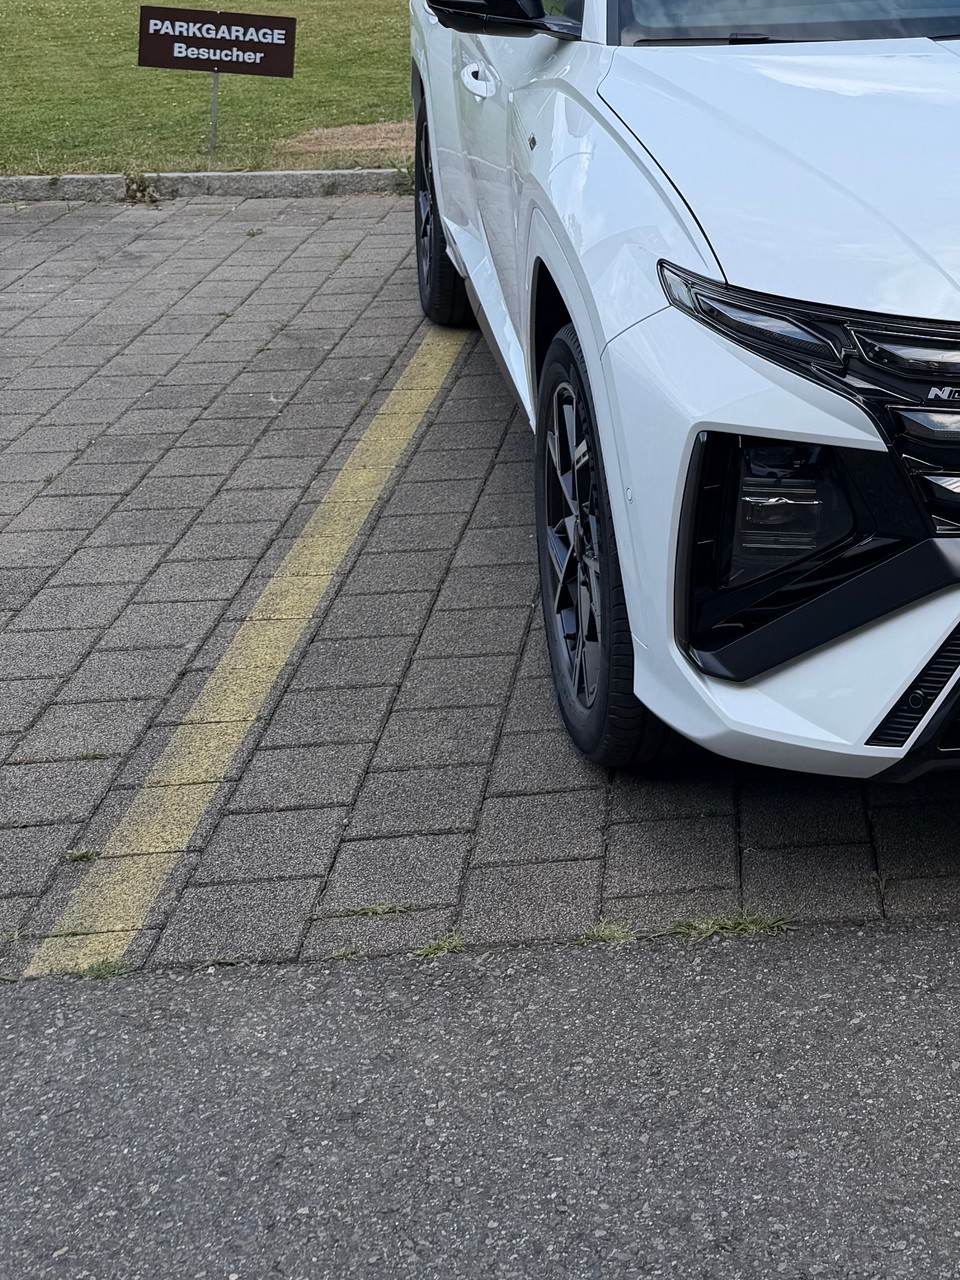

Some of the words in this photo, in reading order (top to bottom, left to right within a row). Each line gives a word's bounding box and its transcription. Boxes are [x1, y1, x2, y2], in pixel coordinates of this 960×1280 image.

[148, 19, 286, 44] PARKGARAGE
[173, 43, 264, 63] Besucher
[927, 386, 952, 400] N
